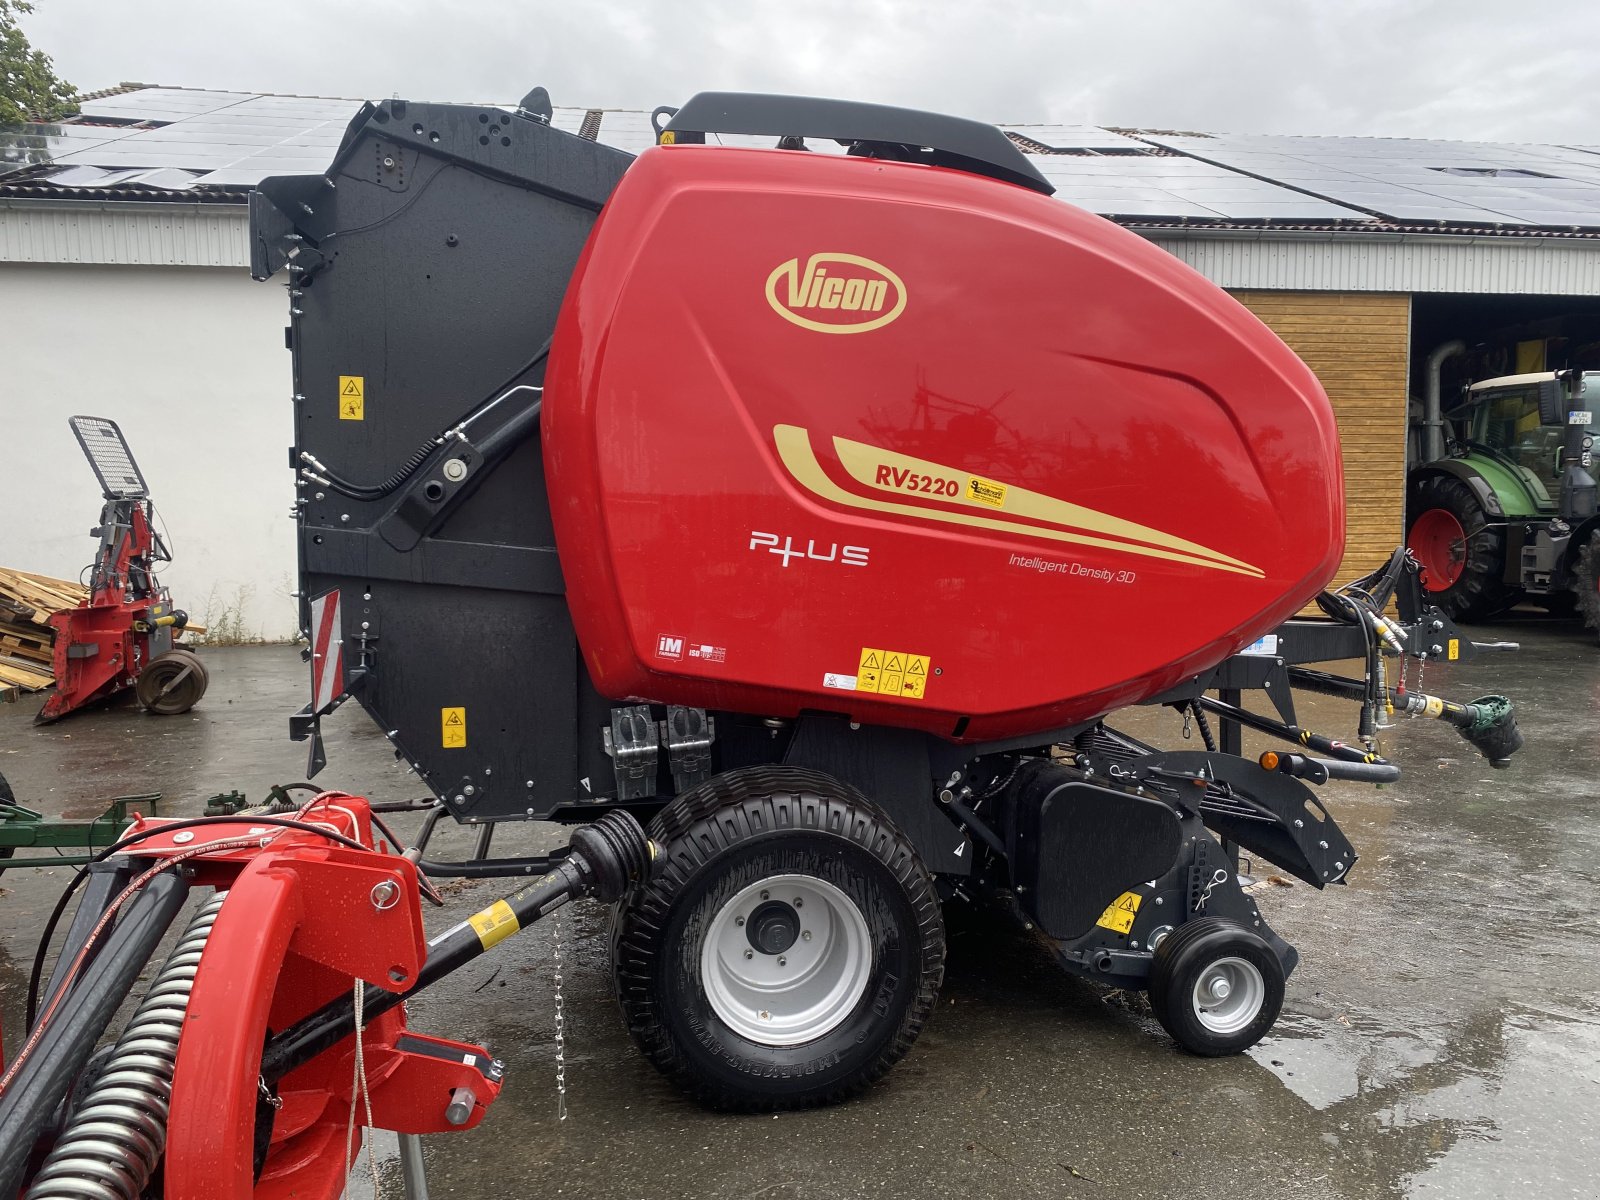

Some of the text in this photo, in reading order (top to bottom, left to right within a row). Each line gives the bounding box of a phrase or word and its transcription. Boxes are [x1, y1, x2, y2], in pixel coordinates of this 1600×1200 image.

[786, 254, 888, 312] Vicon
[875, 464, 959, 497] RV5220
[1008, 553, 1136, 584] Intelligent Density 3D
[659, 637, 683, 653] iM
